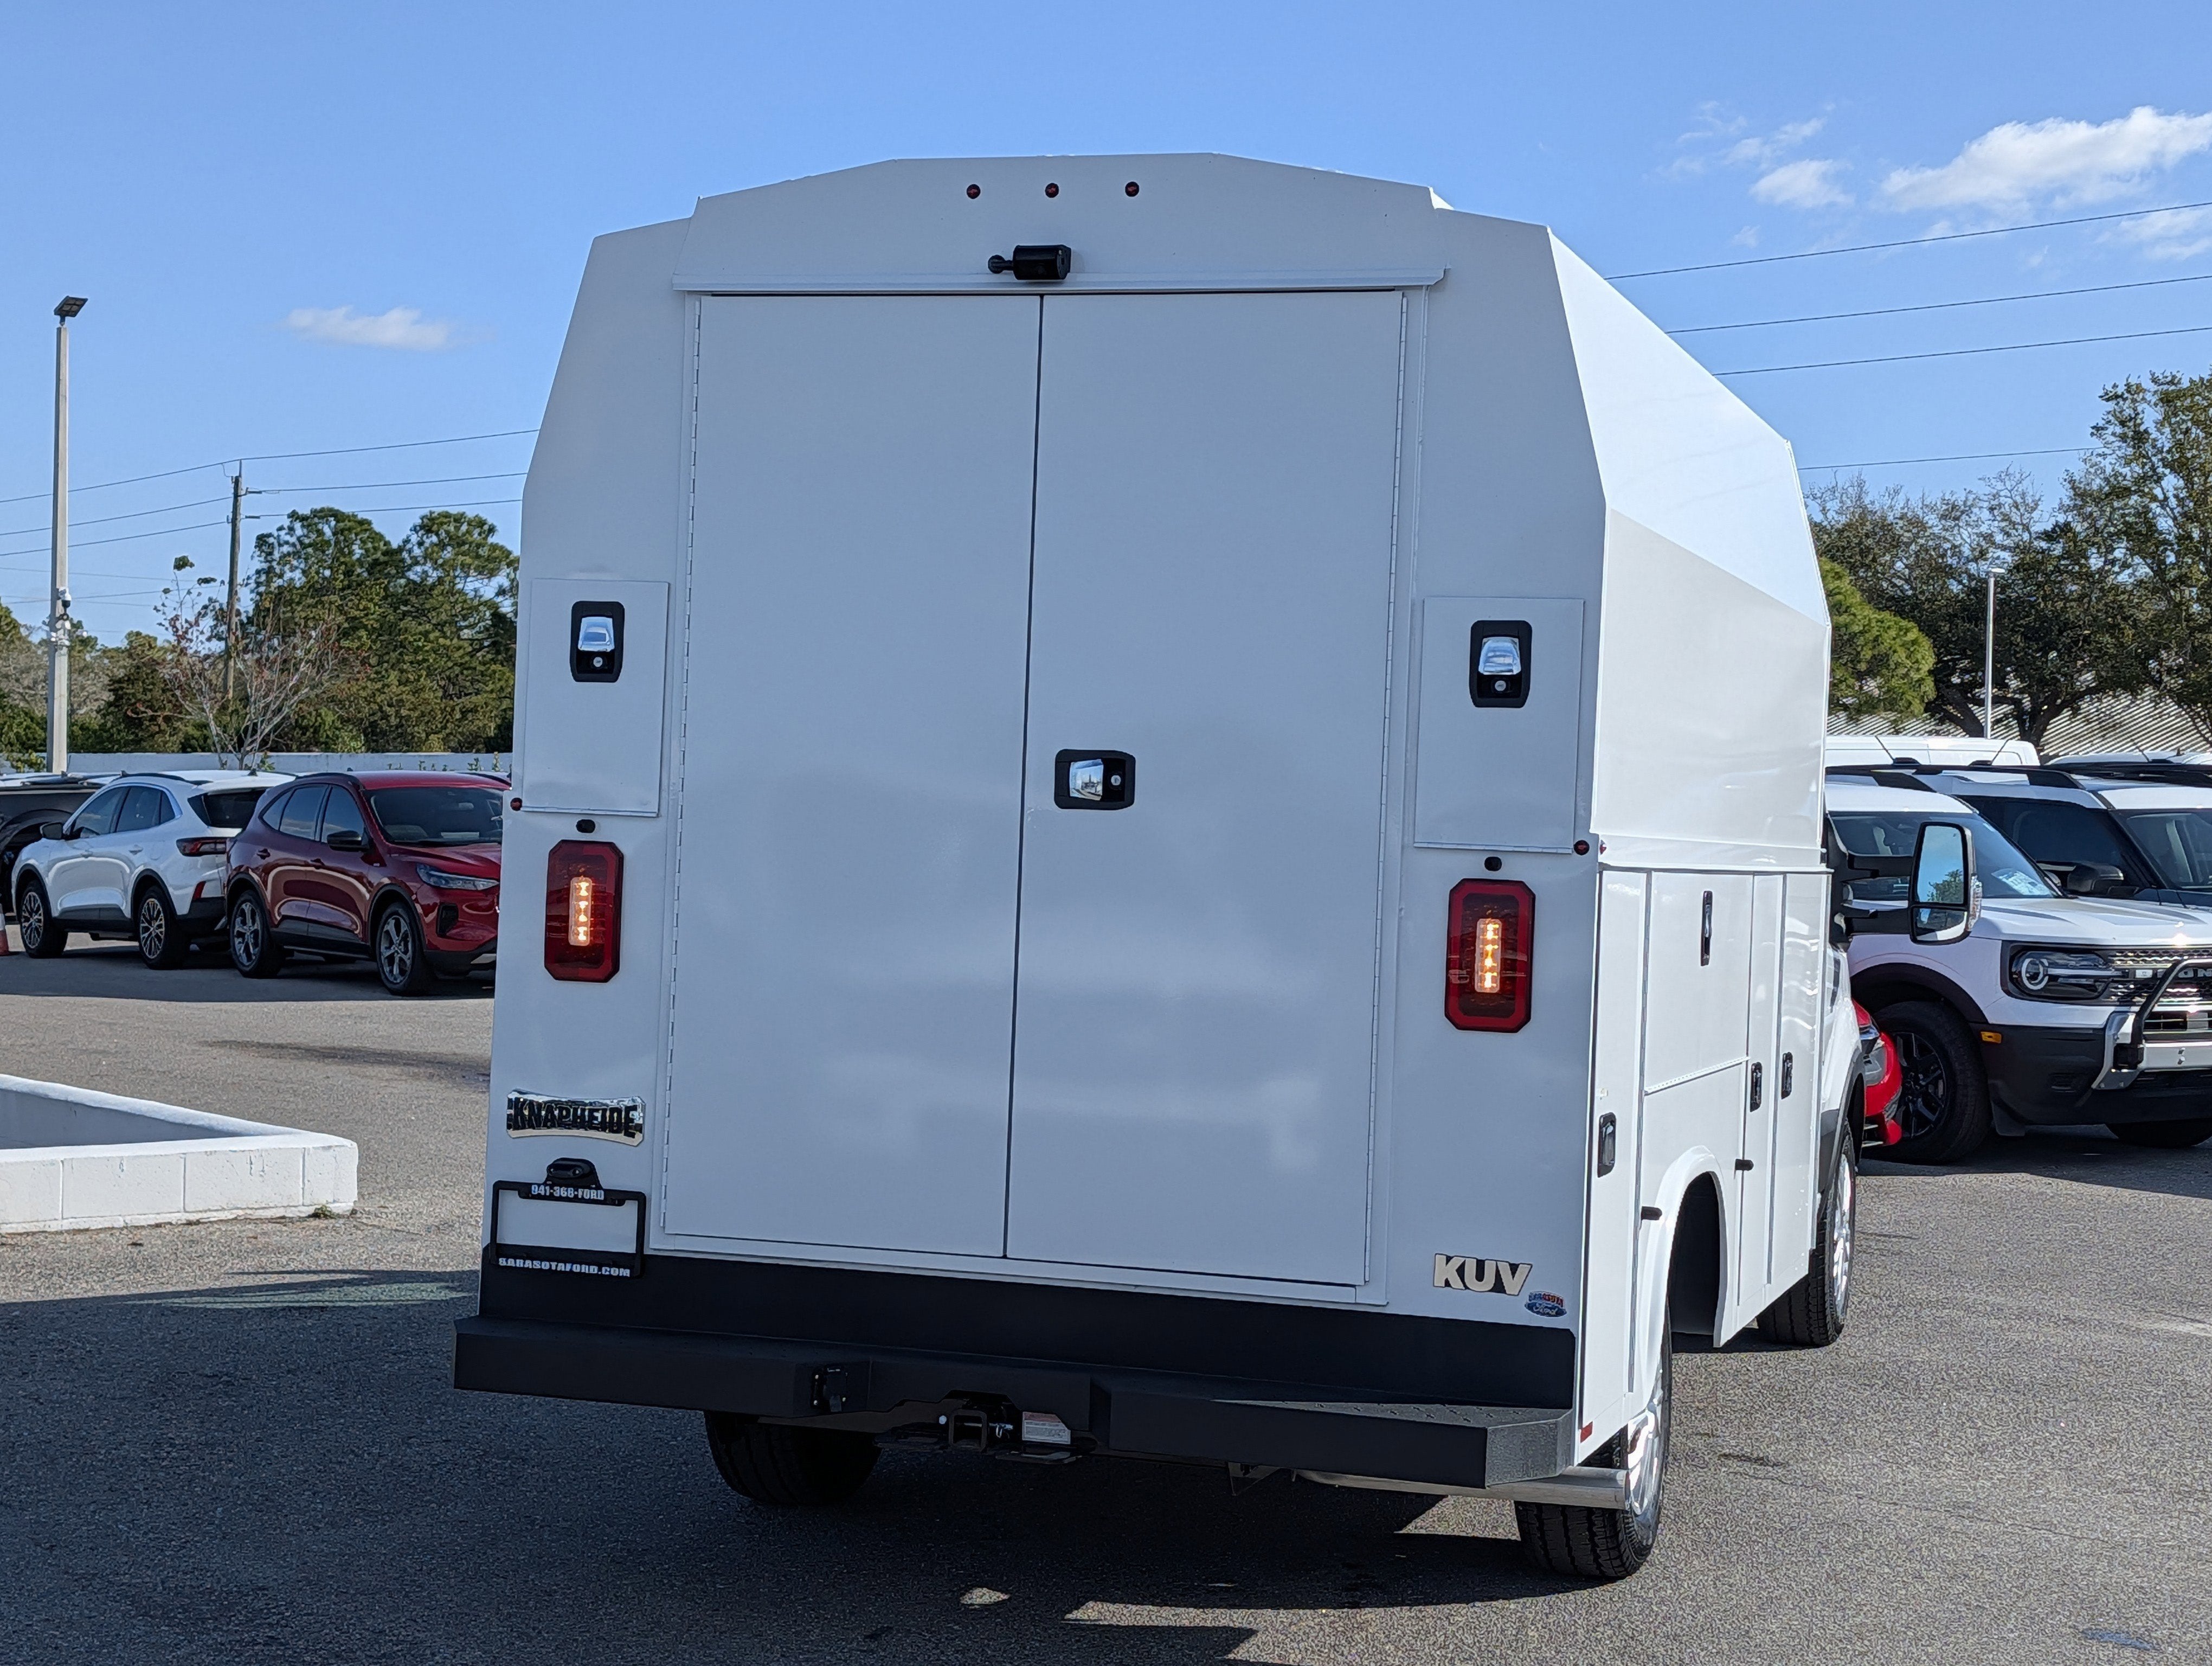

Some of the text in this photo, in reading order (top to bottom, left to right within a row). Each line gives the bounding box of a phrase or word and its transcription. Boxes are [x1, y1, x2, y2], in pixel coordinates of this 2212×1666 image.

[513, 1097, 638, 1139] KNAPHEIDE
[498, 1258, 631, 1277] SARASOTAFORD.COM
[1433, 1253, 1533, 1296] KUV
[1533, 1302, 1559, 1316] Ford
